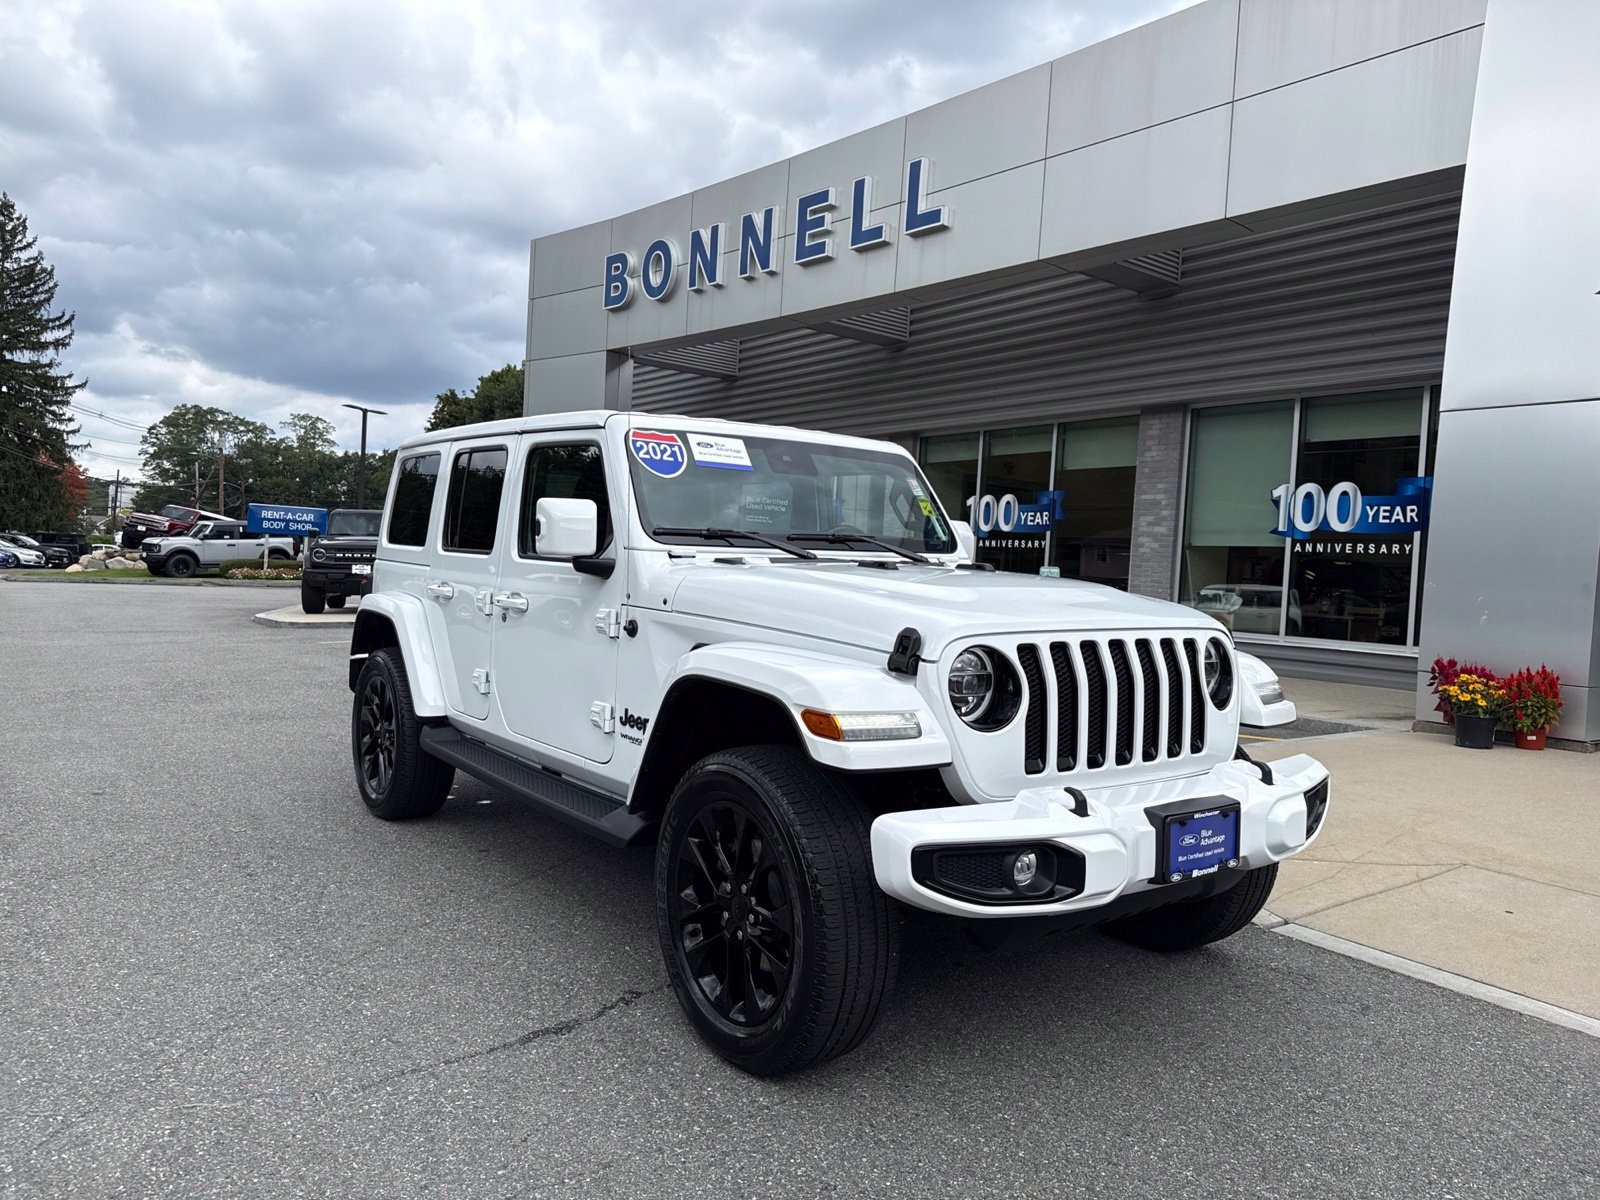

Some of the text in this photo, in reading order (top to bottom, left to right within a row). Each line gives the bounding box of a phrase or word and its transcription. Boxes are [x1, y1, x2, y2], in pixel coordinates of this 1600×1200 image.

[603, 156, 949, 312] BONNELL
[635, 440, 683, 463] 2021
[762, 497, 789, 506] Certified
[1271, 481, 1418, 533] 100 YEAR
[763, 504, 786, 512] Vehicle
[966, 493, 1049, 532] 100 YEAR
[261, 510, 314, 521] RENT-A-CAR
[262, 520, 313, 531] BODY SHOP
[978, 539, 1046, 549] ANNIVERSARY
[1294, 542, 1412, 555] ANNIVERSARY
[620, 708, 650, 735] Jeep
[1194, 810, 1220, 819] Winchester
[1200, 829, 1213, 837] Blue
[1181, 835, 1198, 845] Ford
[1200, 834, 1226, 847] Advantage
[1192, 864, 1219, 878] Bonnell
